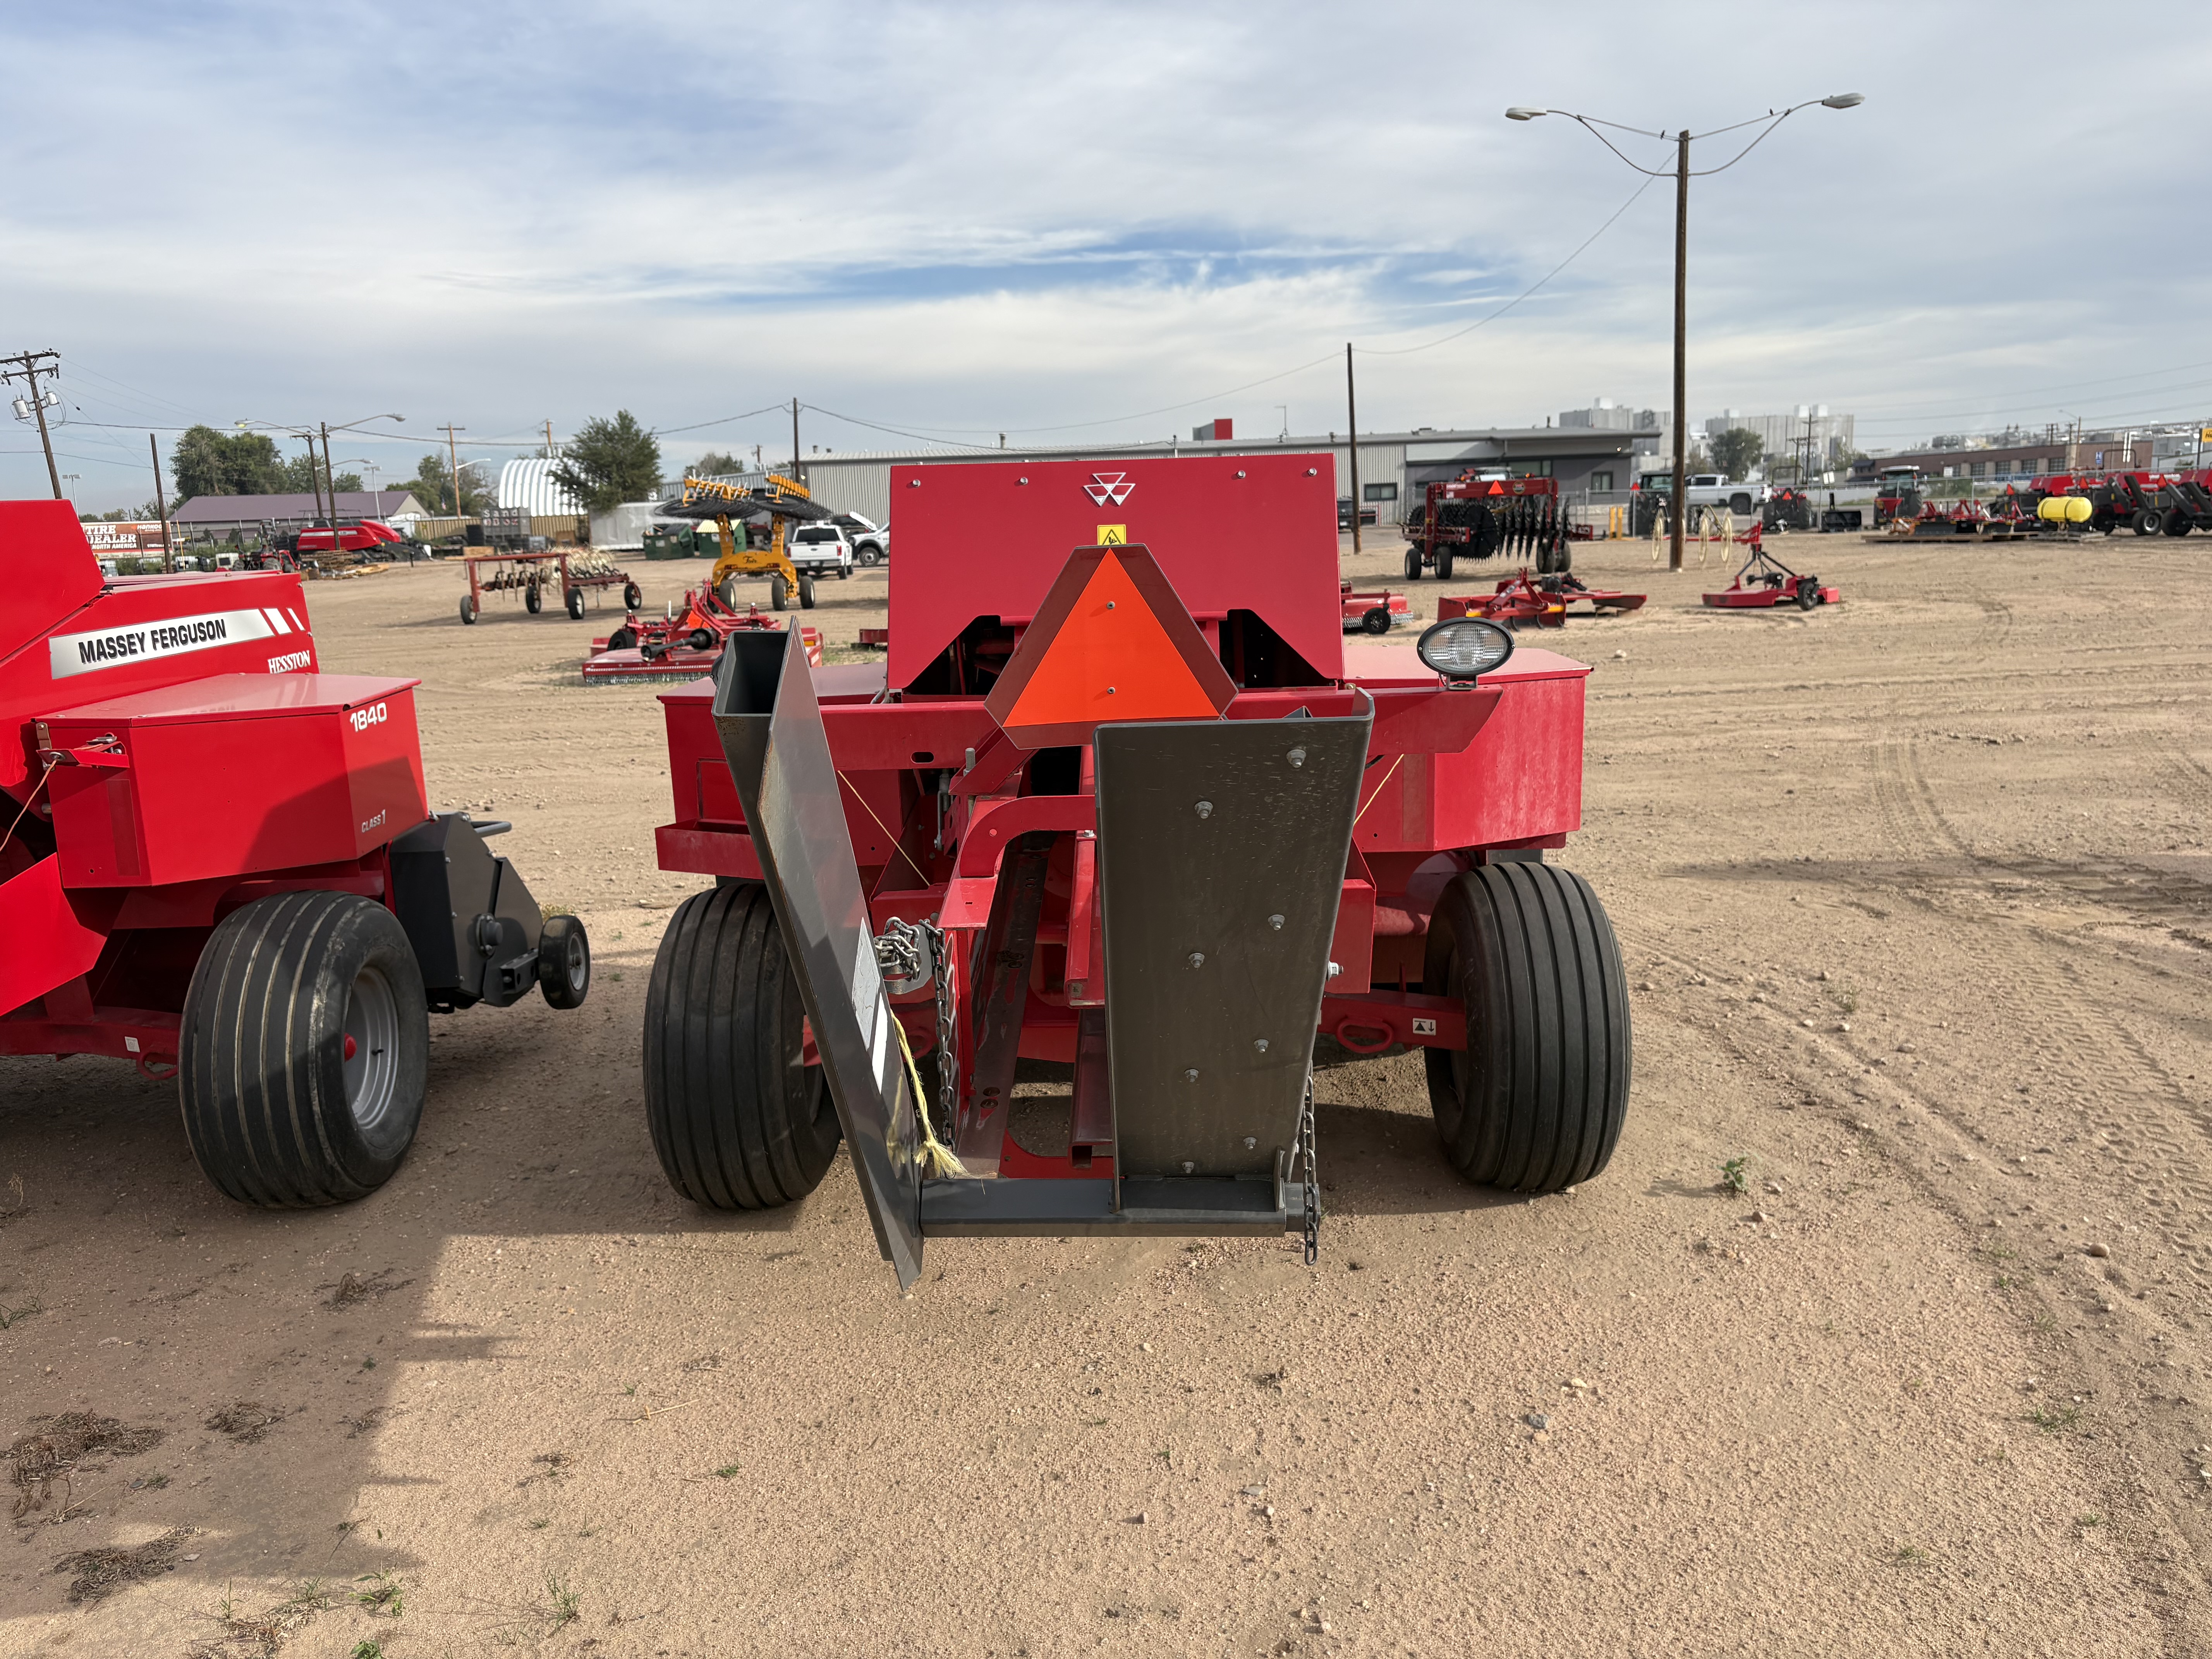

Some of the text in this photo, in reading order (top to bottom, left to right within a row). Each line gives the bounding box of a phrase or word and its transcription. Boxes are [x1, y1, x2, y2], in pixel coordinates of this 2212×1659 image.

[85, 525, 116, 534] TIRE
[78, 620, 227, 664] MASSEY FERGUSON
[268, 651, 311, 674] HESSTON
[350, 702, 387, 732] 1840
[362, 814, 381, 833] CLASS
